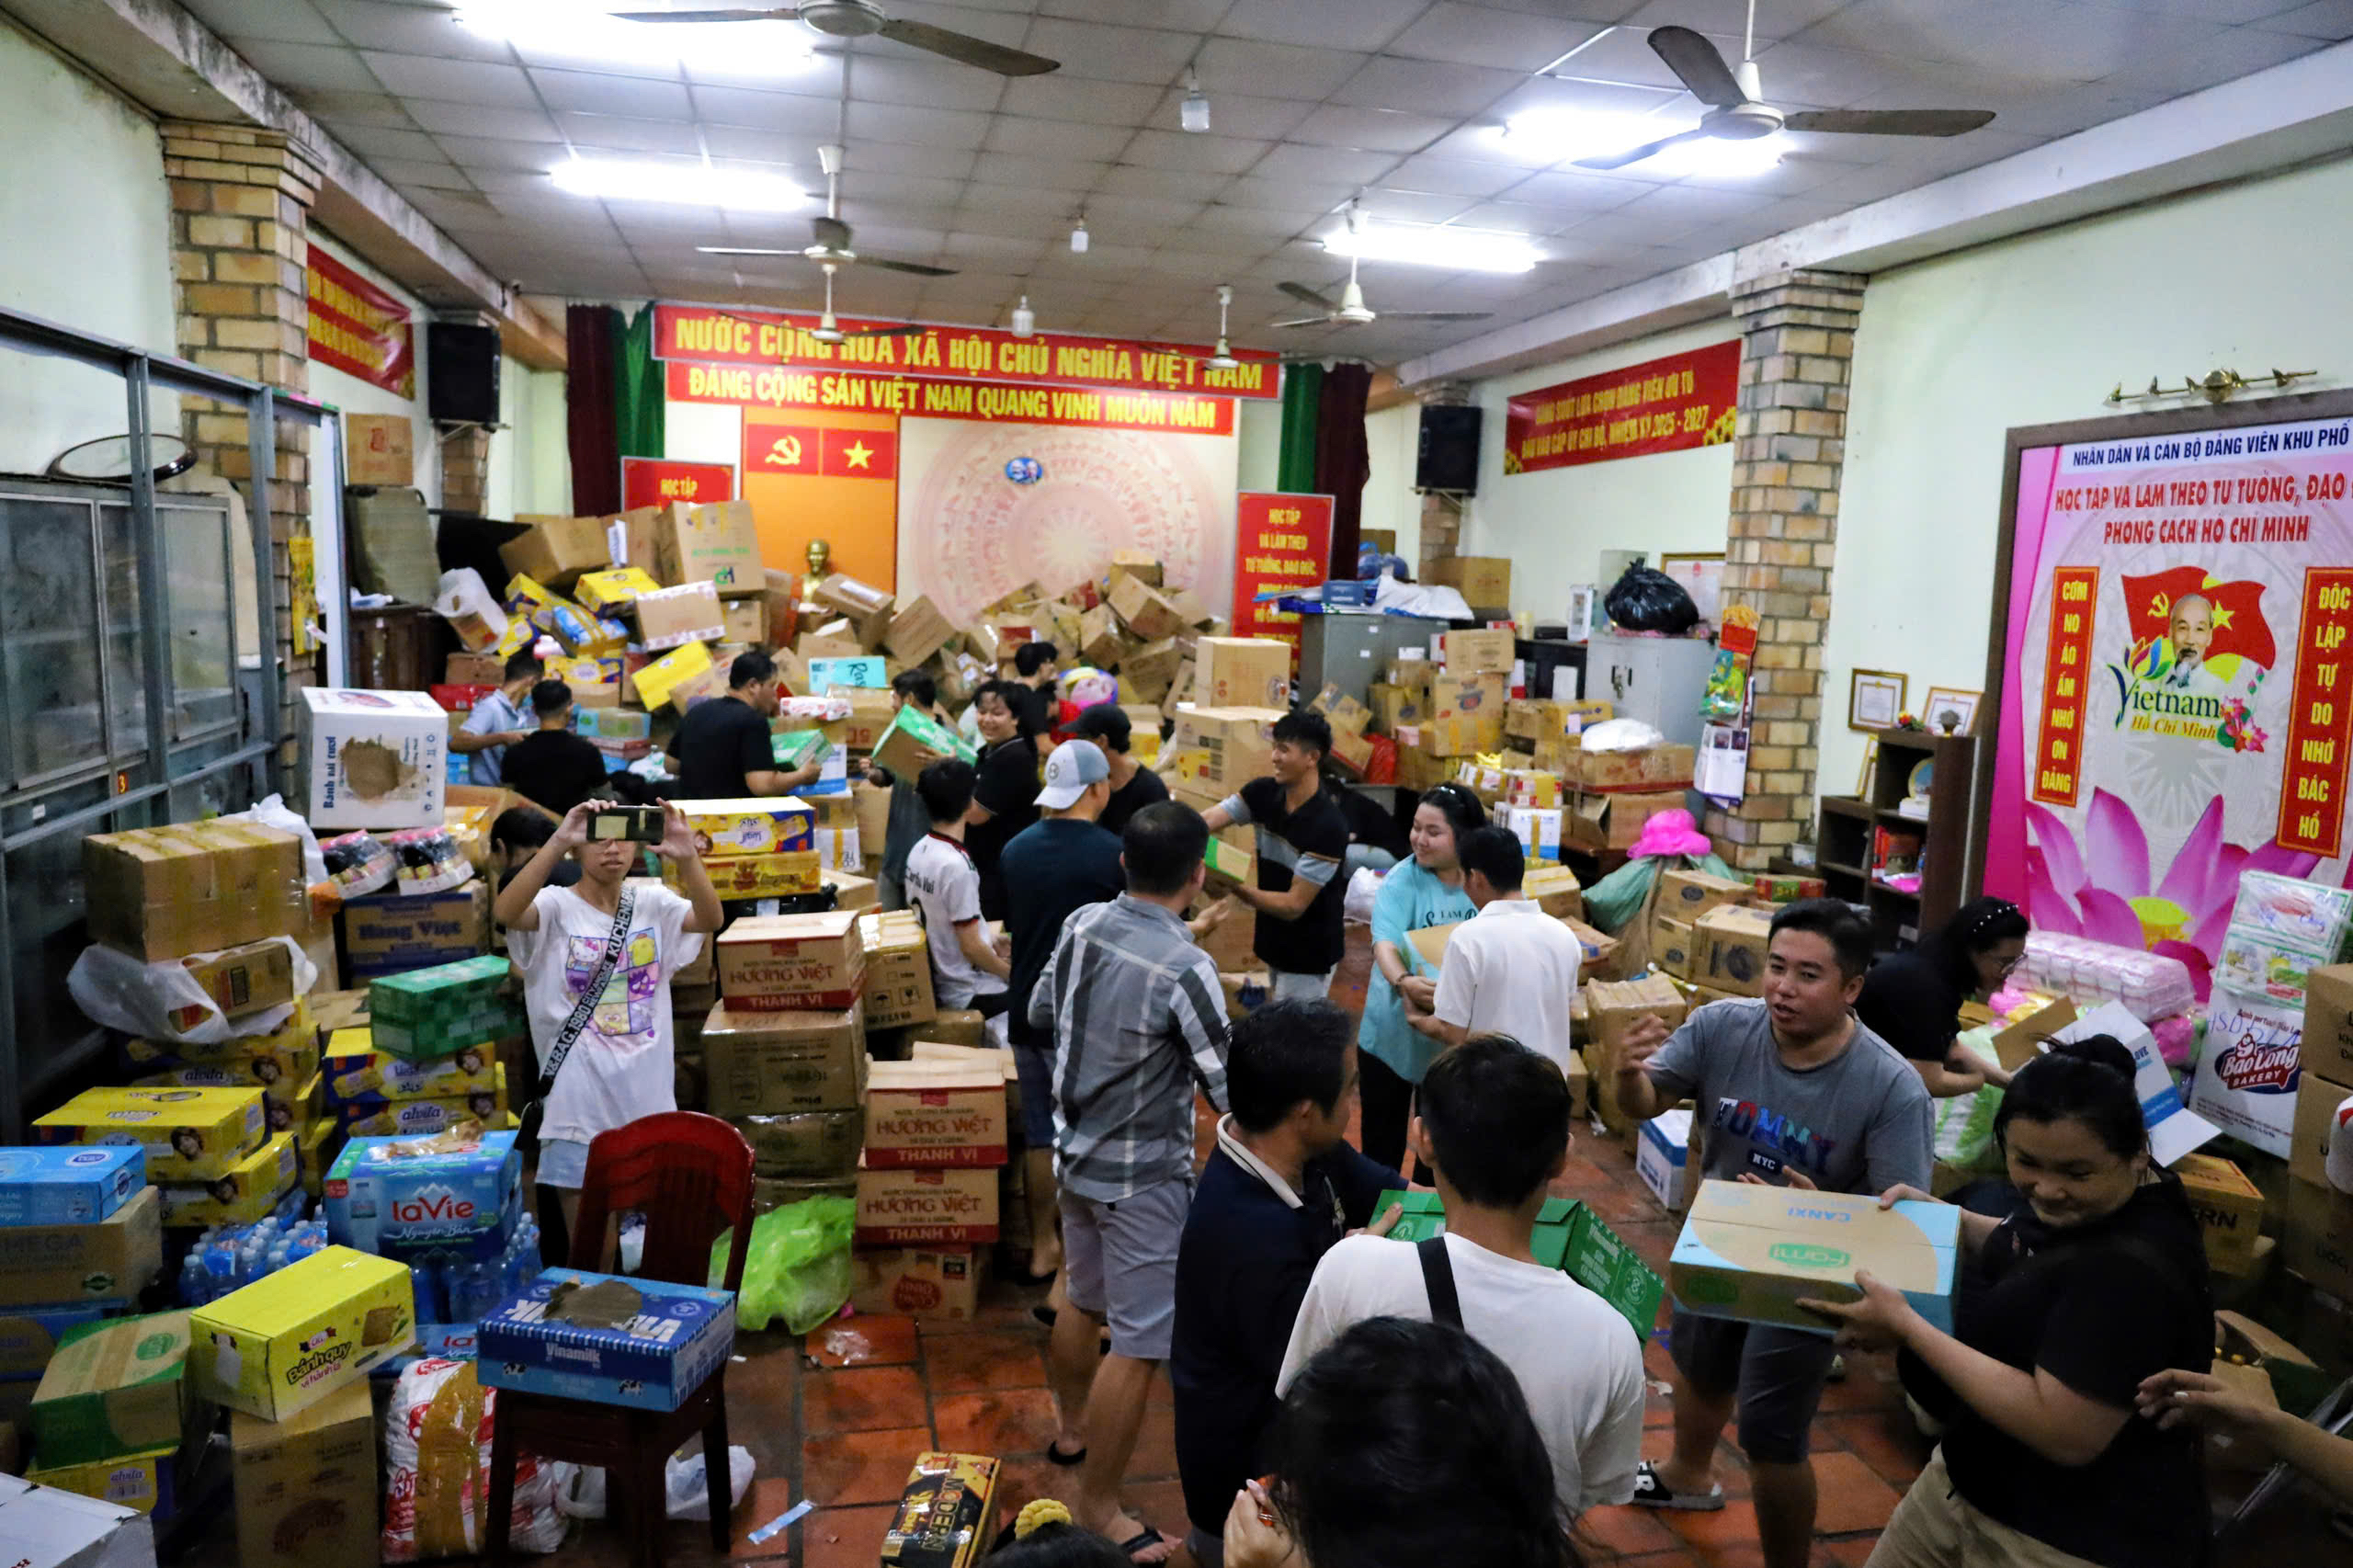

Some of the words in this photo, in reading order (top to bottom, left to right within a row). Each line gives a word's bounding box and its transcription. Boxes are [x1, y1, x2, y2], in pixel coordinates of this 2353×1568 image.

[676, 316, 752, 354] NƯỚC
[759, 319, 832, 364] CỘNG
[904, 332, 941, 368] XÃ
[949, 335, 992, 377] HỘI
[999, 336, 1050, 375] CHỦ
[1057, 344, 1132, 381] NGHĨA
[1142, 350, 1195, 390] VIỆT
[1204, 362, 1263, 389] NAM
[689, 363, 752, 400] ĐẢNG
[756, 367, 817, 407] CỘNG
[821, 371, 866, 407] SẢN
[870, 375, 919, 415] VIỆT
[926, 383, 972, 412] NAM
[977, 387, 1048, 418] QUANG
[1052, 391, 1100, 421] VINH
[1106, 392, 1169, 426] MUÔN
[1170, 397, 1215, 428] NĂM
[2074, 446, 2104, 466] NHÂN
[2108, 443, 2131, 464] DÂN
[2135, 442, 2151, 461] VÀ
[2154, 439, 2180, 460] CÁN
[2184, 437, 2201, 461] BỘ
[2205, 432, 2243, 457] ĐẢNG
[2247, 430, 2279, 453] VIÊN
[2283, 430, 2314, 450] KHU
[2318, 419, 2352, 447] PHỐ
[2170, 480, 2208, 506] THEO
[2307, 472, 2346, 508] ĐẠO
[2104, 519, 2154, 544] PHONG
[2262, 515, 2312, 541] MINH
[2319, 584, 2351, 613] ĐỘC
[2063, 614, 2080, 632] NO
[2315, 621, 2346, 653] LẬP
[2061, 640, 2077, 665] ÁO
[2317, 663, 2339, 694] TỰ
[2107, 664, 2222, 728] Vietnam
[2311, 702, 2333, 724] DO
[2181, 719, 2217, 739] Minh
[2298, 774, 2330, 801] BÁC
[2298, 811, 2320, 838] HỒ
[749, 994, 802, 1008] THANH
[2222, 1055, 2253, 1077] Bao
[2255, 1046, 2300, 1069] Long
[2233, 1070, 2281, 1086] BAKERY
[1713, 1096, 1837, 1175] TOMMY
[897, 1149, 956, 1162] THANH
[1752, 1153, 1777, 1170] NYC
[1787, 1206, 1852, 1223] CANXI
[887, 1227, 944, 1241] THANH
[287, 1352, 324, 1385] Bánh
[322, 1341, 353, 1370] quy
[544, 1341, 601, 1364] Vinamilk
[921, 1477, 965, 1551] MODERN
